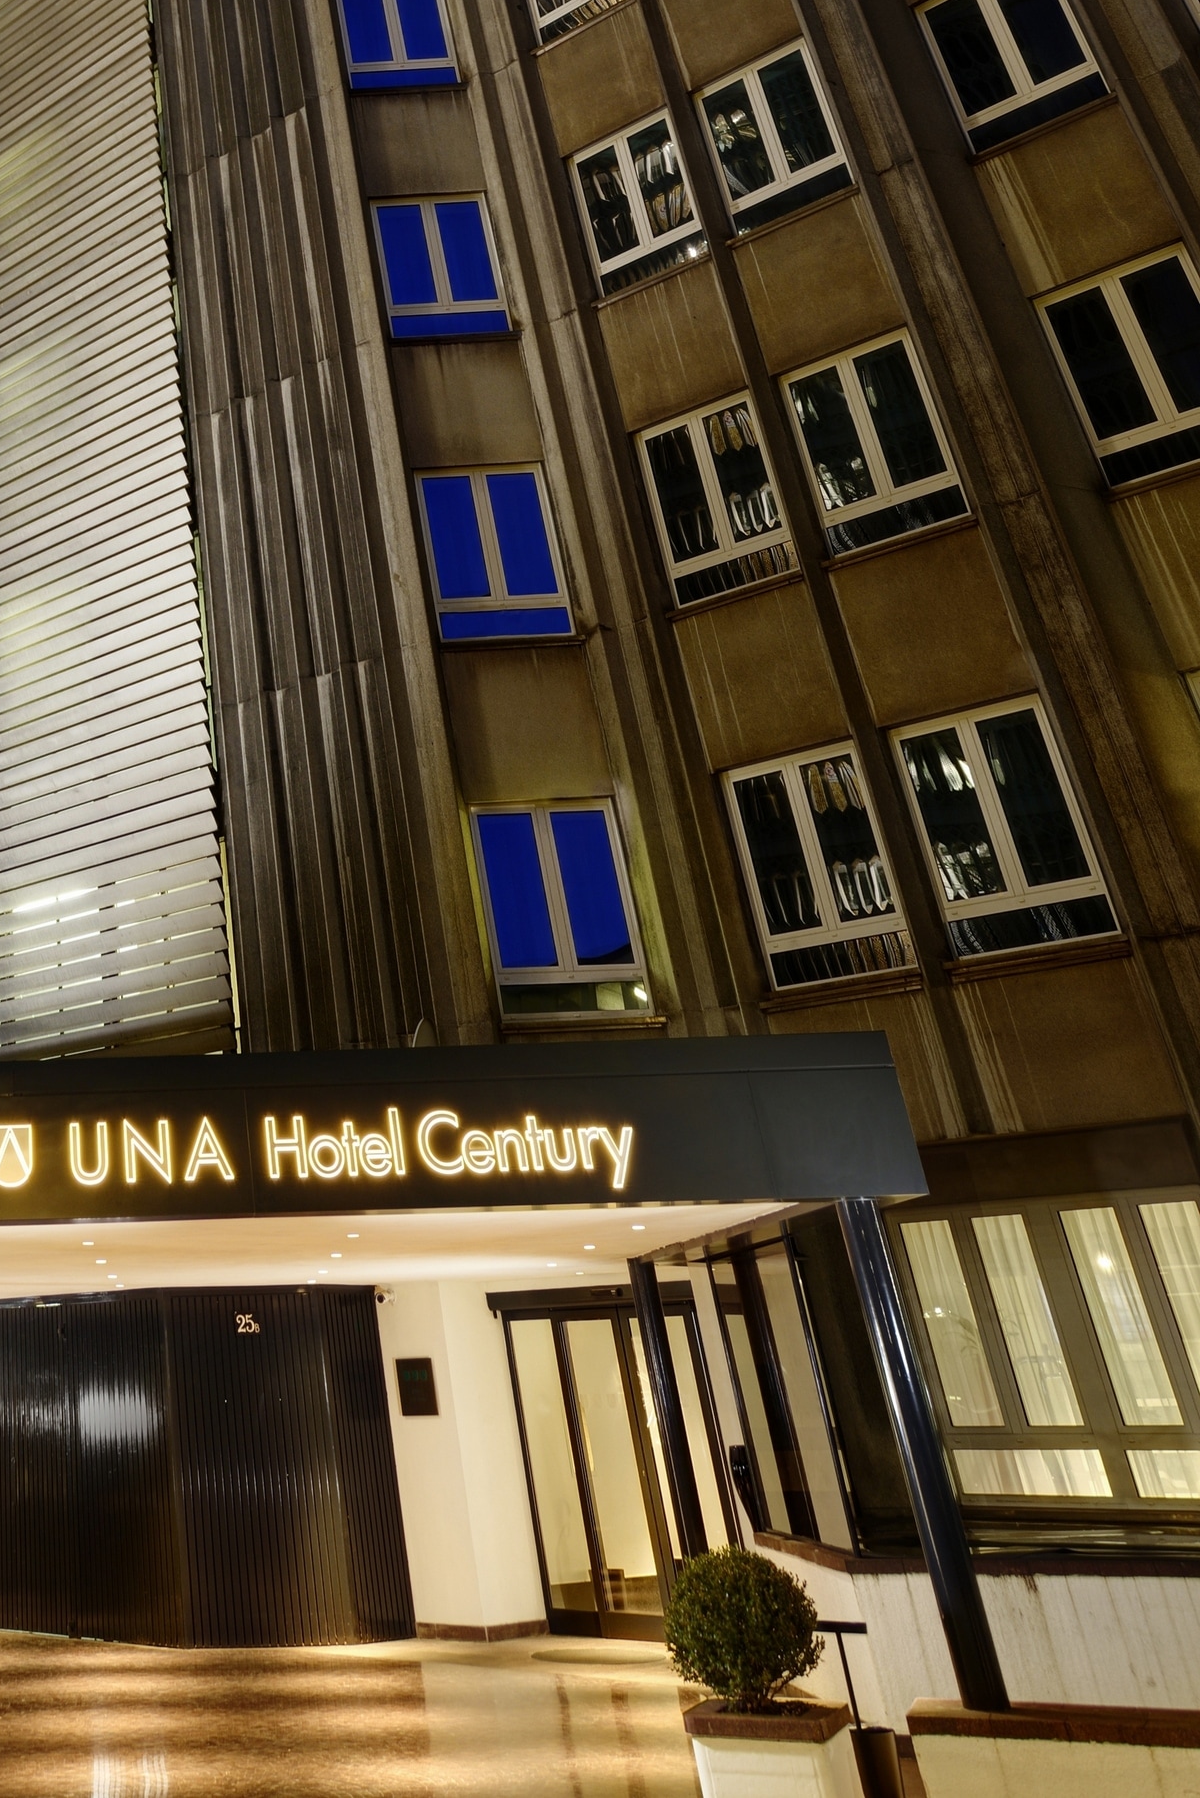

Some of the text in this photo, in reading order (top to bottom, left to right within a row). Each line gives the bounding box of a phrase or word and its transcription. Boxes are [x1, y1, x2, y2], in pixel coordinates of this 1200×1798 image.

[69, 1107, 633, 1189] UNA Hotel Century
